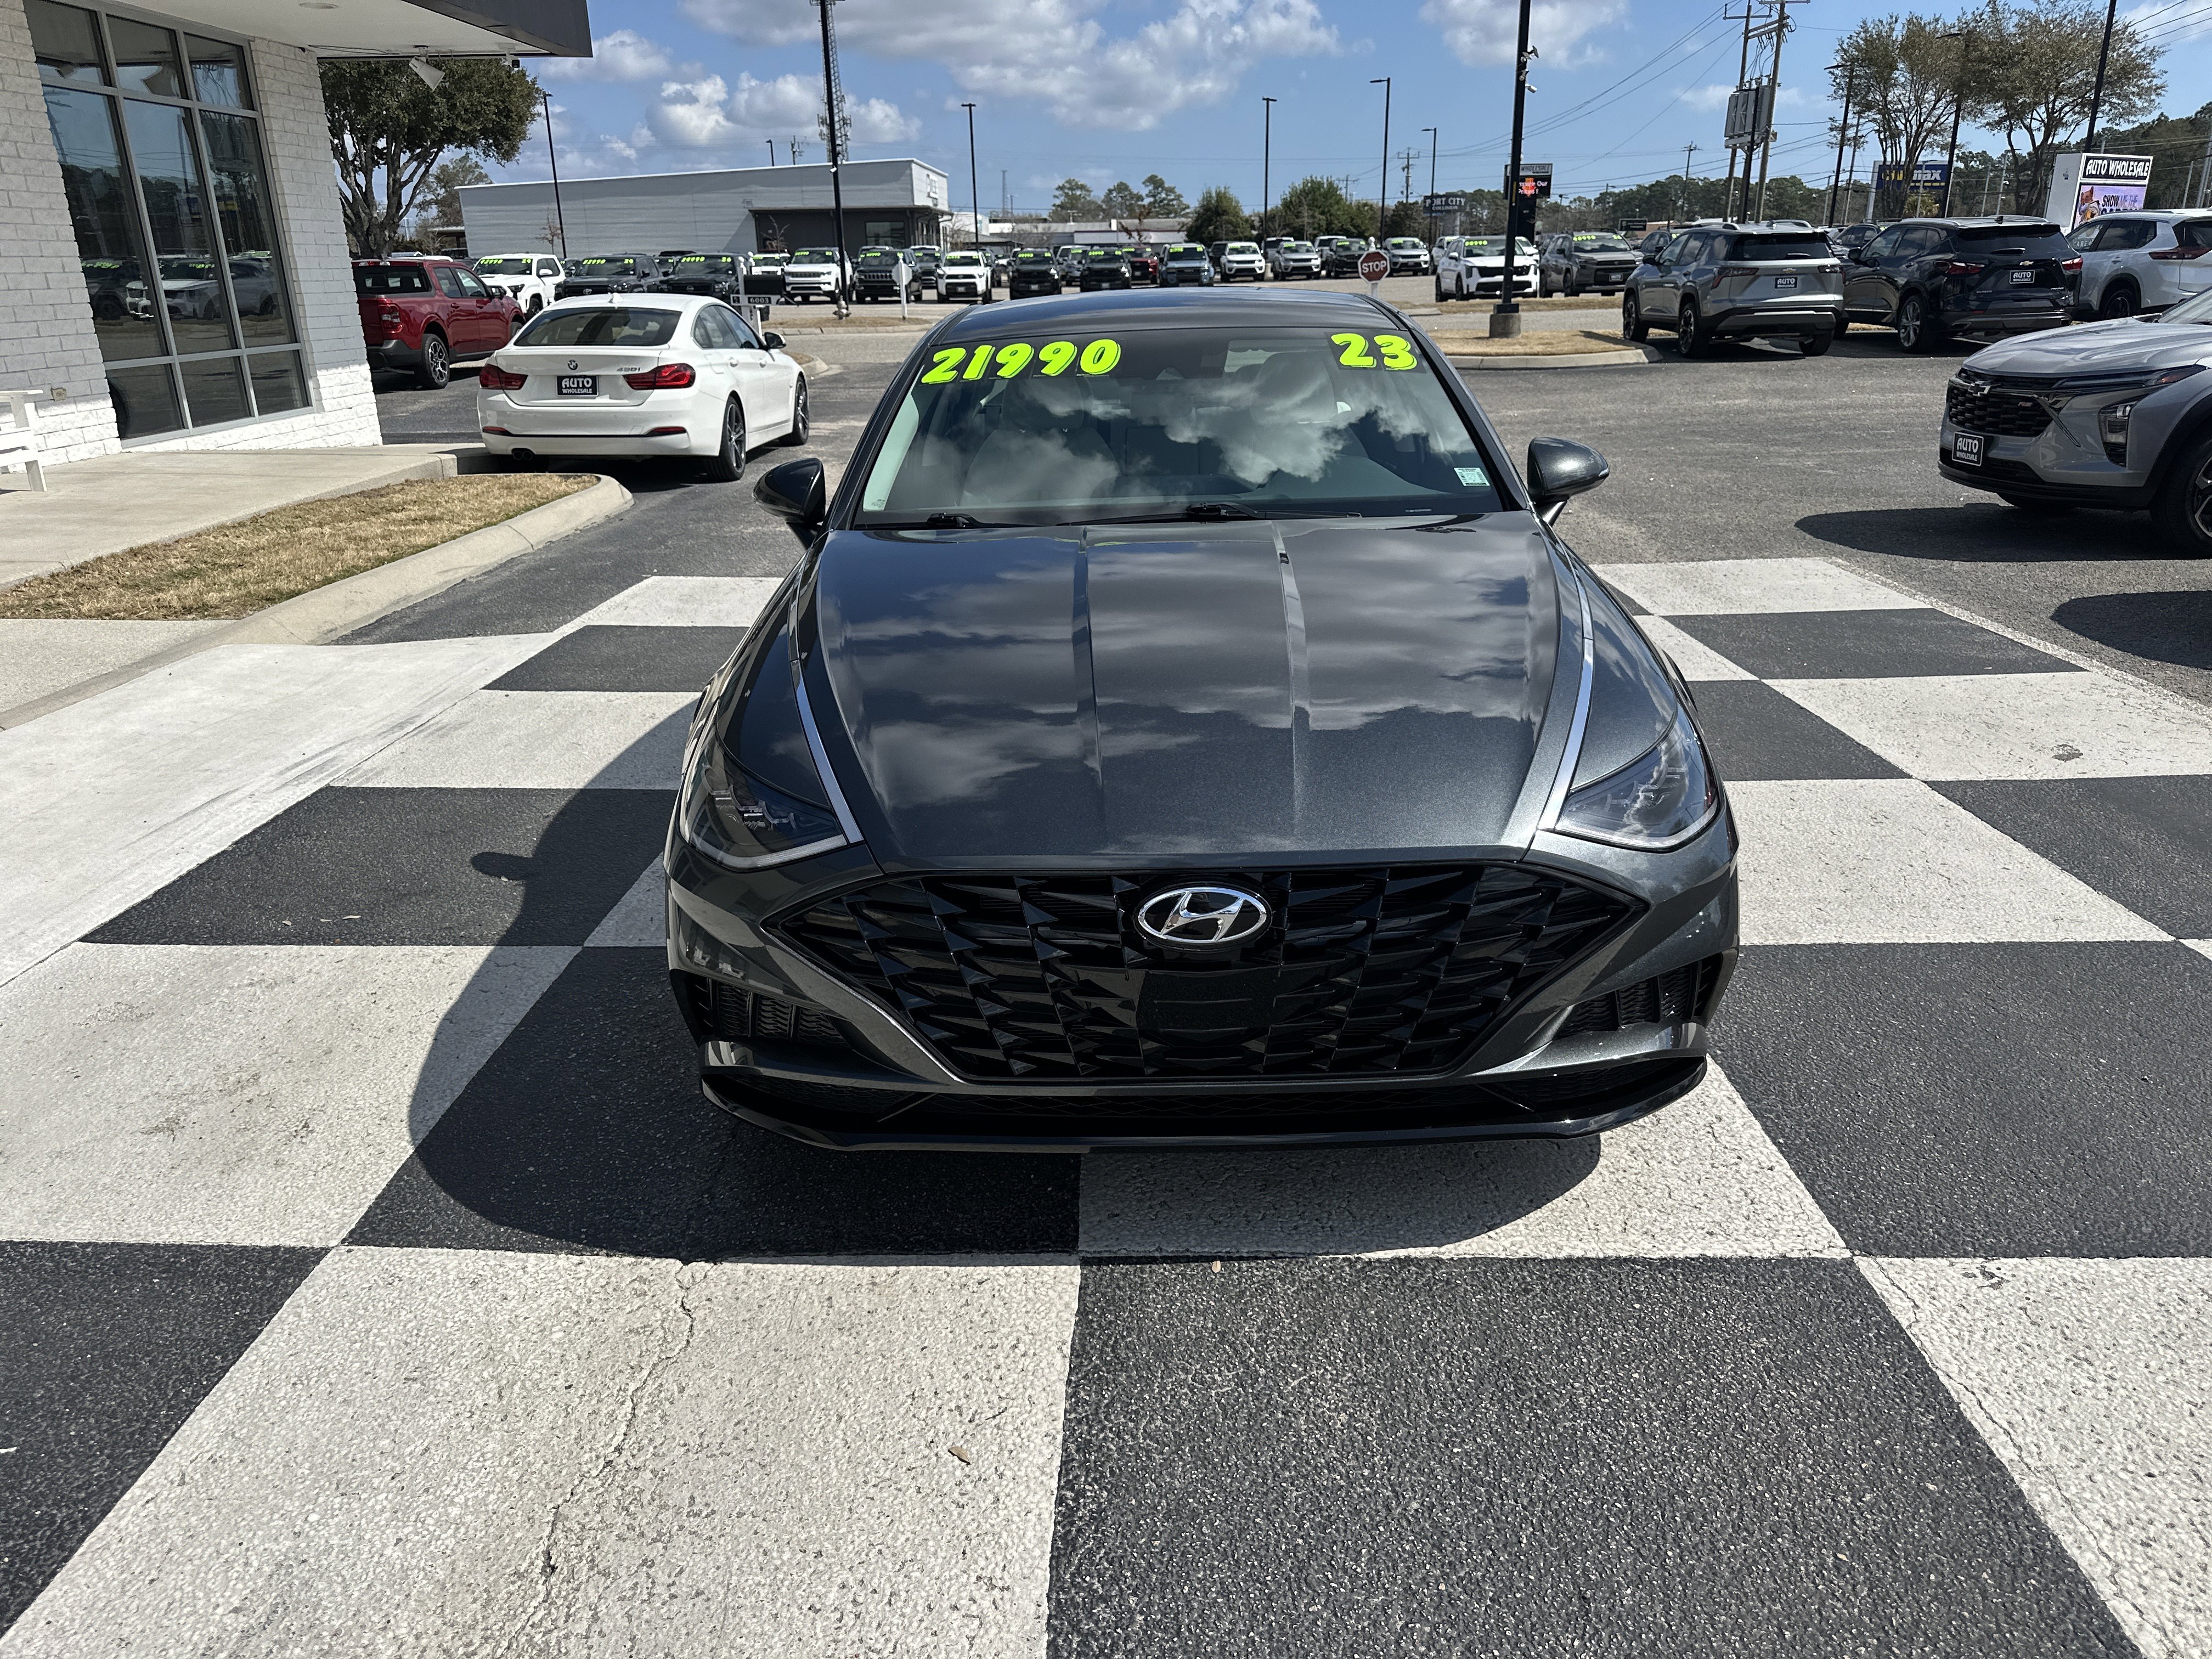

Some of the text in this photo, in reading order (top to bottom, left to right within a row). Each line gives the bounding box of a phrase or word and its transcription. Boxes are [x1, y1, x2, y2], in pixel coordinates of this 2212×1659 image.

[2086, 159, 2150, 178] AUTO WHOLESALE
[1448, 197, 1466, 206] CITY
[2102, 194, 2120, 208] SHOW
[1362, 260, 1387, 273] STOP
[1330, 332, 1418, 370] 23
[921, 338, 1121, 384] 21990
[561, 377, 592, 388] AUTO
[1956, 437, 1979, 453] AUTO
[1956, 450, 1978, 461] WHOLESALE
